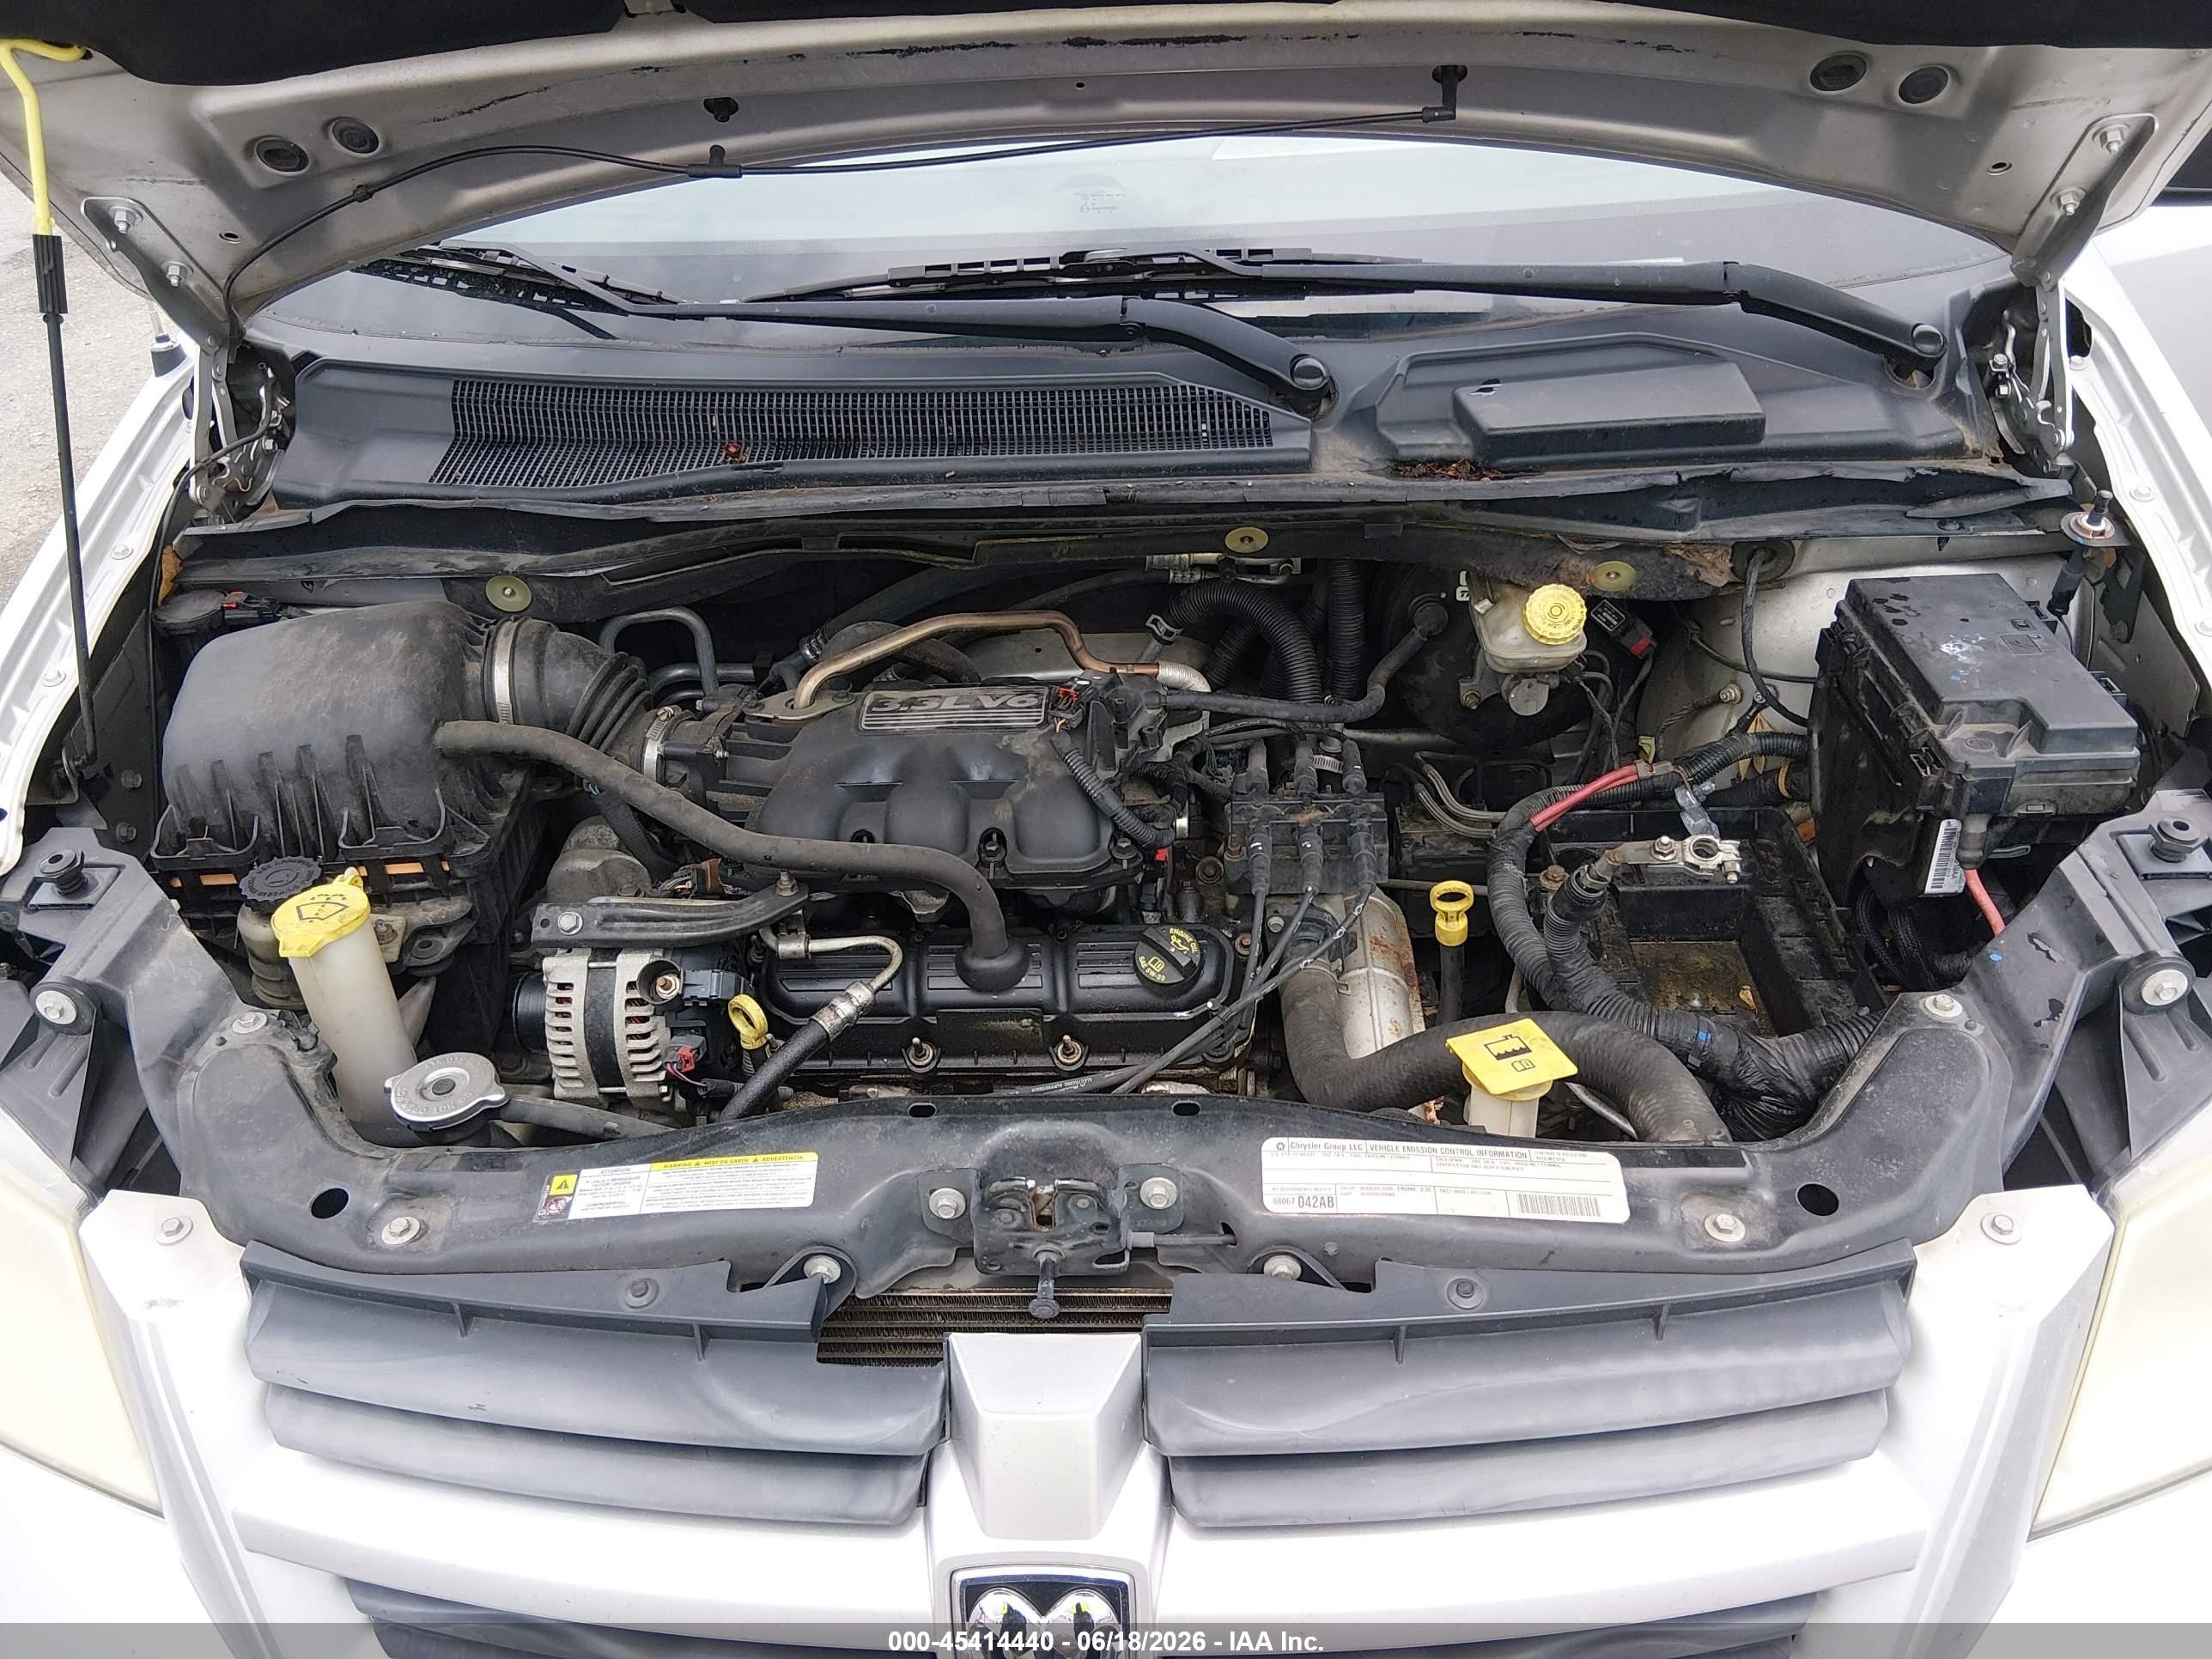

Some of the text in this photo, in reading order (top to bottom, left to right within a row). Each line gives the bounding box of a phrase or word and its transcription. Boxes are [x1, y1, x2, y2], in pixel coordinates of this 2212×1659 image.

[872, 693, 1039, 712] 3.3L V6
[1170, 927, 1194, 943] ENGINE
[1139, 956, 1165, 981] SAE 5W-20
[1291, 1141, 1322, 1152] Chrysler
[1324, 1142, 1346, 1152] Group
[1370, 1144, 1401, 1152] VEHICLE
[1402, 1146, 1437, 1154] EMISSION
[1440, 1147, 1474, 1156] CONTROL
[1476, 1149, 1528, 1159] INFORMATION
[1297, 1195, 1334, 1208] 042AB
